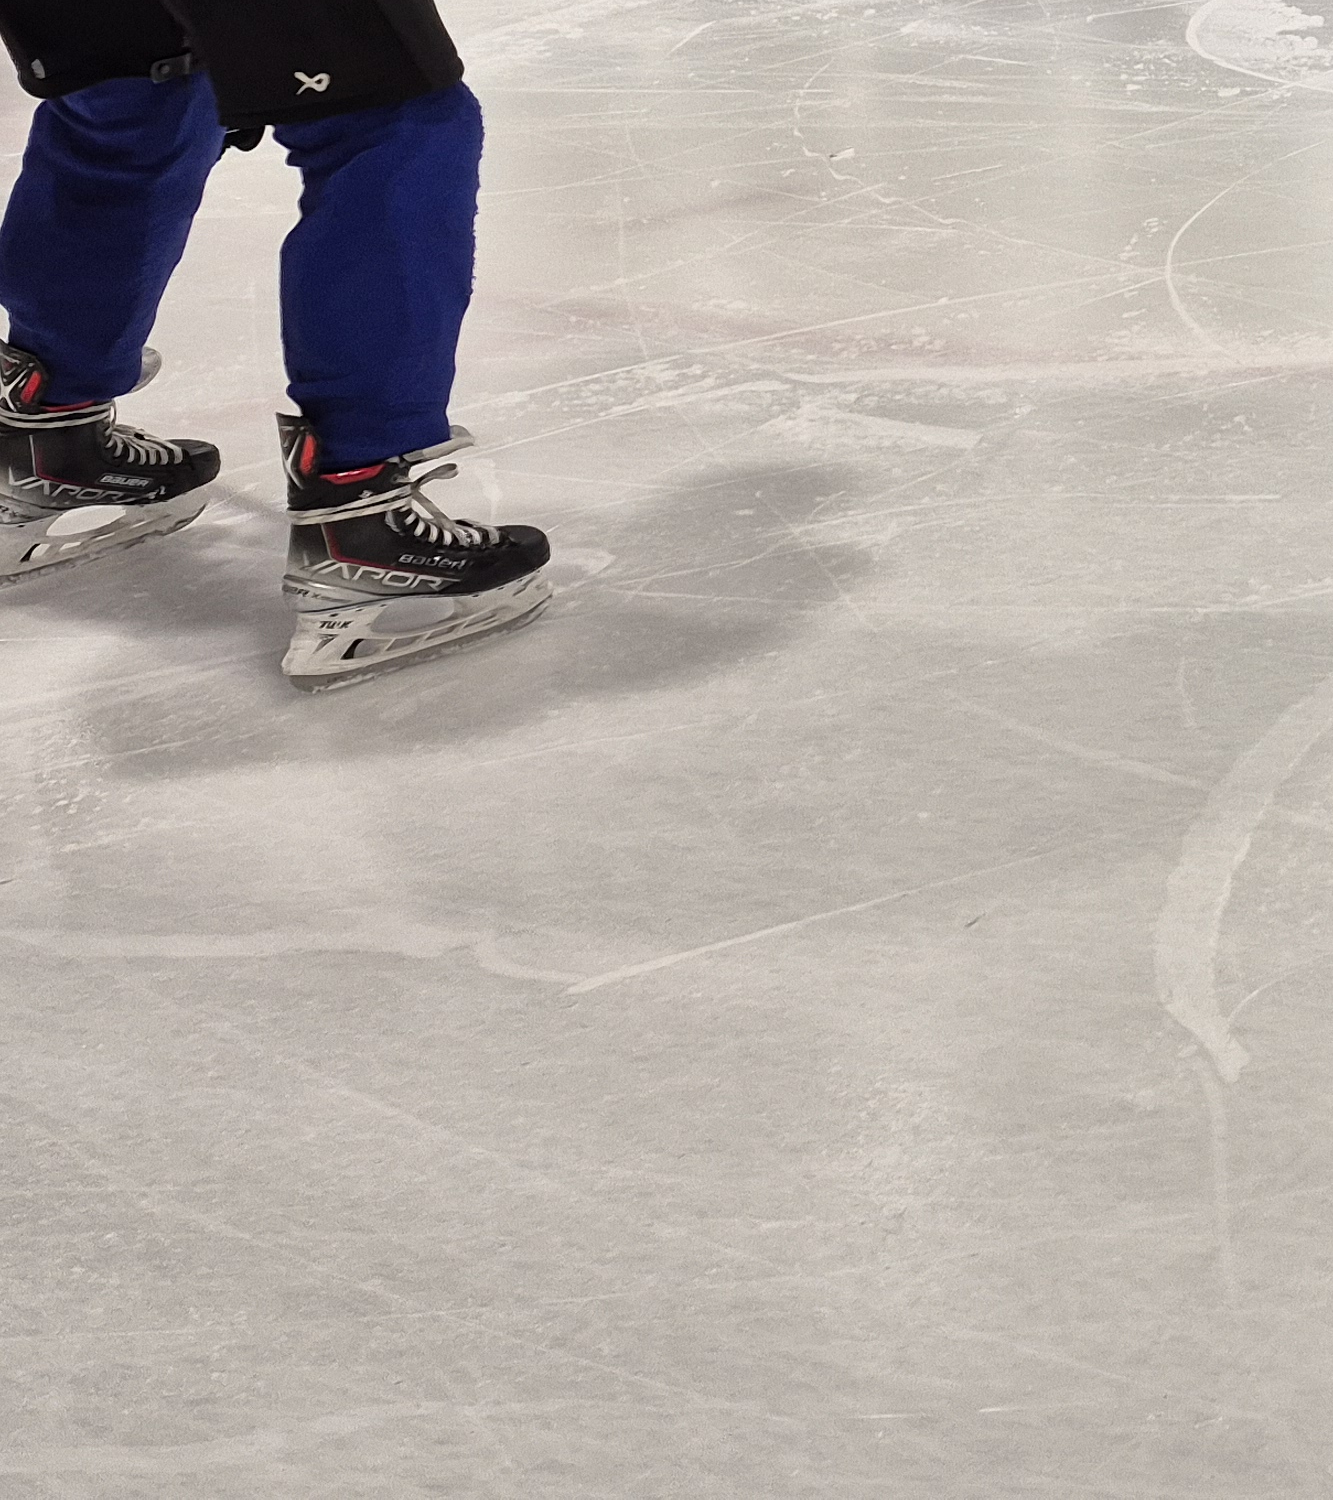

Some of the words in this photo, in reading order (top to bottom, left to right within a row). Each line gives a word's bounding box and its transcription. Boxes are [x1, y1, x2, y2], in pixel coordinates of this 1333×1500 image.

[8, 466, 126, 502] VAPOR
[99, 475, 149, 488] BAUER
[301, 553, 463, 592] VAPOR
